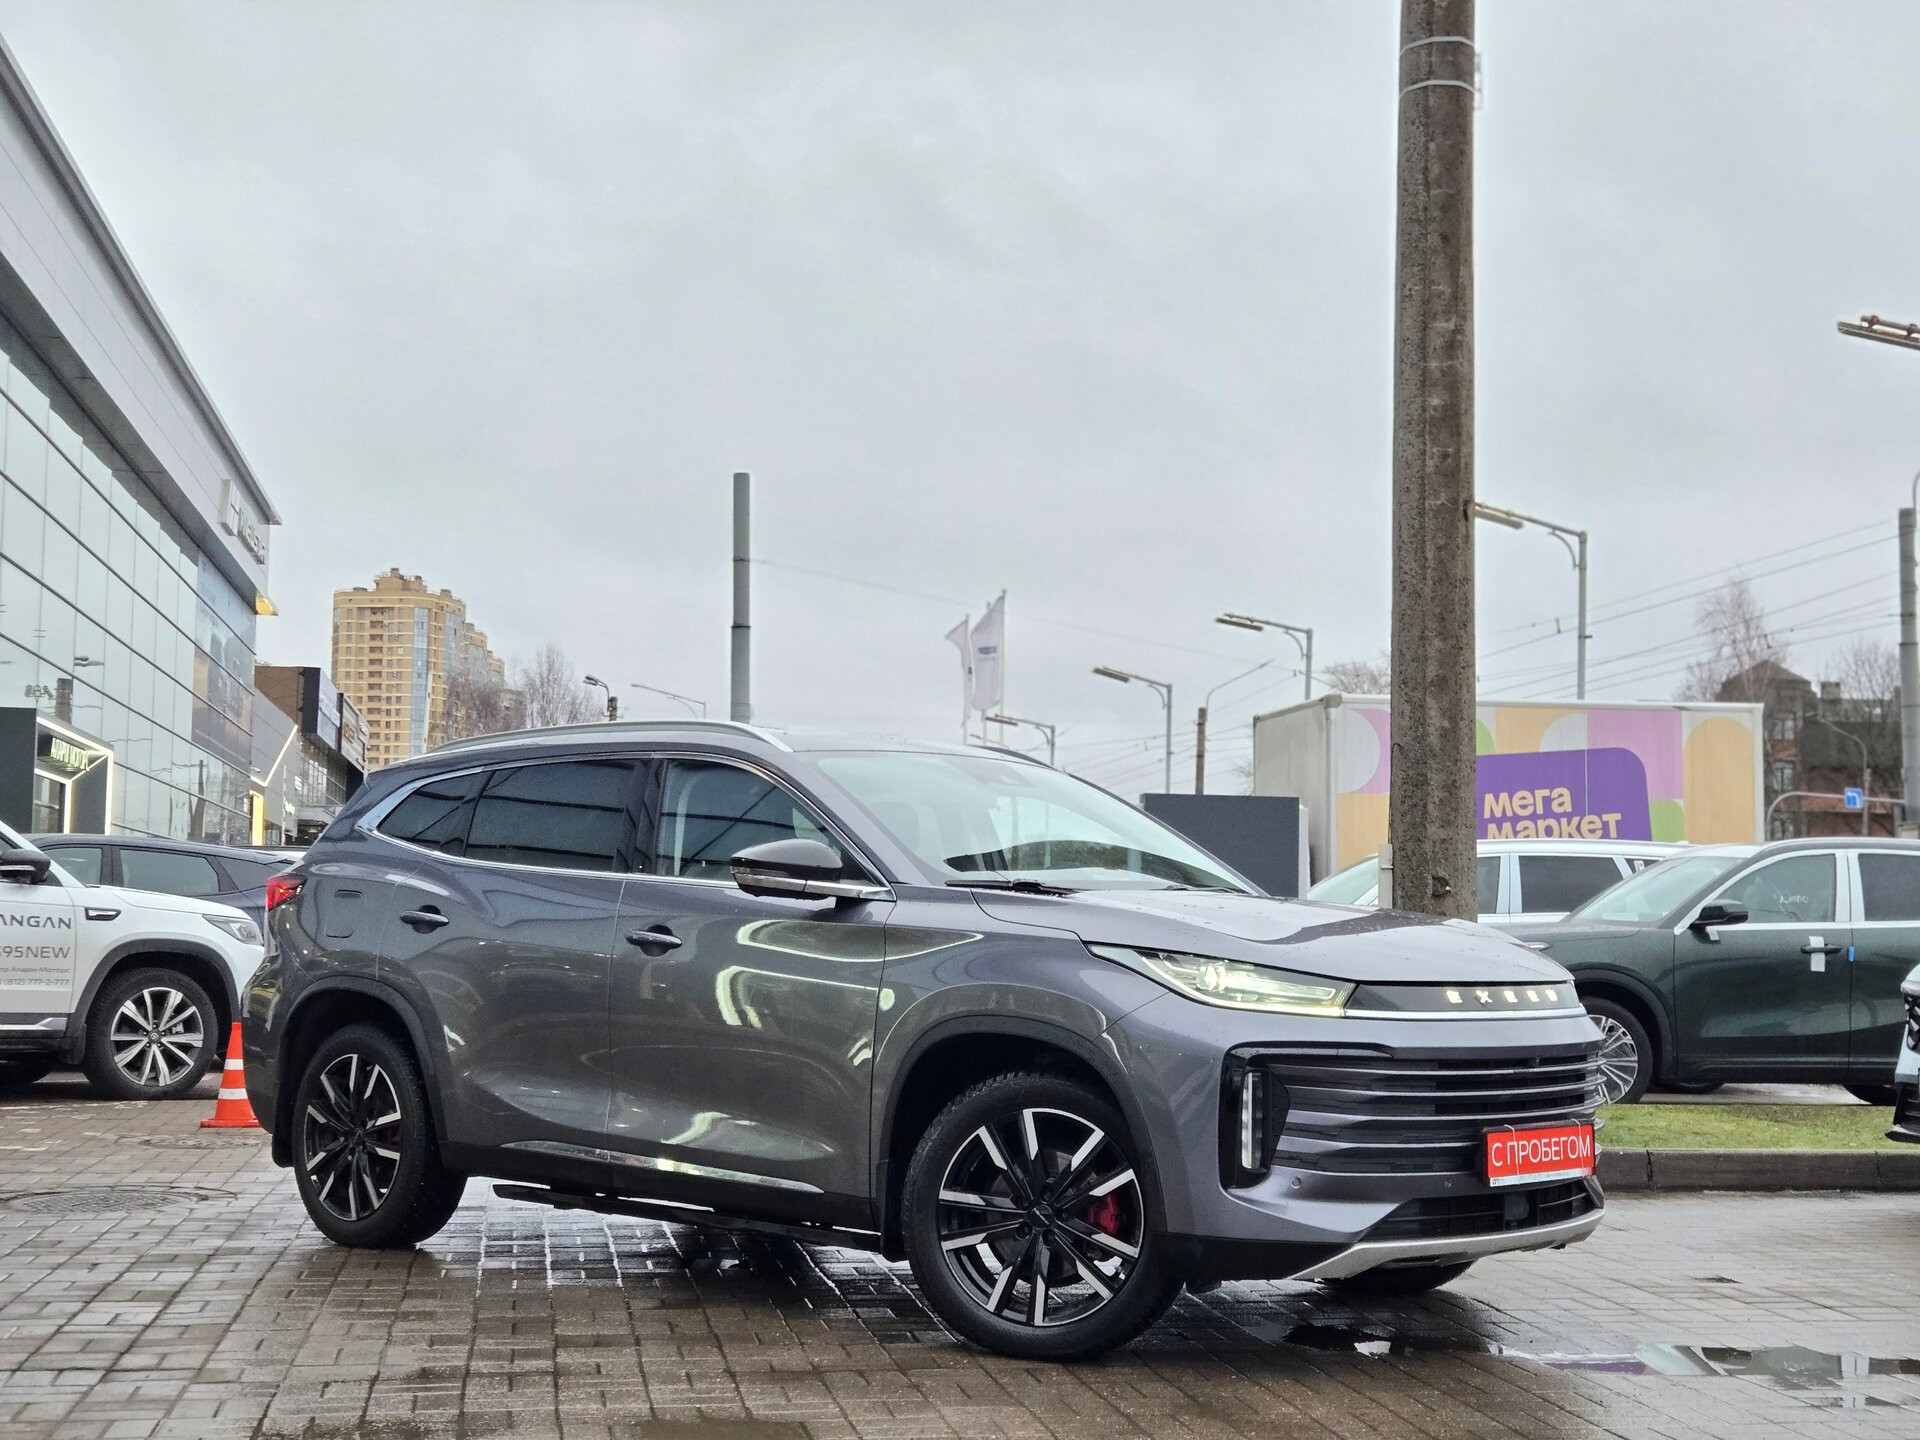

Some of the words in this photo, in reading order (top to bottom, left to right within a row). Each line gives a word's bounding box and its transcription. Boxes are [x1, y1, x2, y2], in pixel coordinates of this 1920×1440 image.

[1483, 787, 1572, 819] мега
[1487, 813, 1622, 839] маркет
[0, 945, 71, 959] 95NEW
[27, 977, 70, 986] 777-2-777
[1446, 989, 1559, 1004] EXEED
[1491, 1142, 1503, 1167] С
[1507, 1134, 1591, 1166] ПРОБЕГОМ
